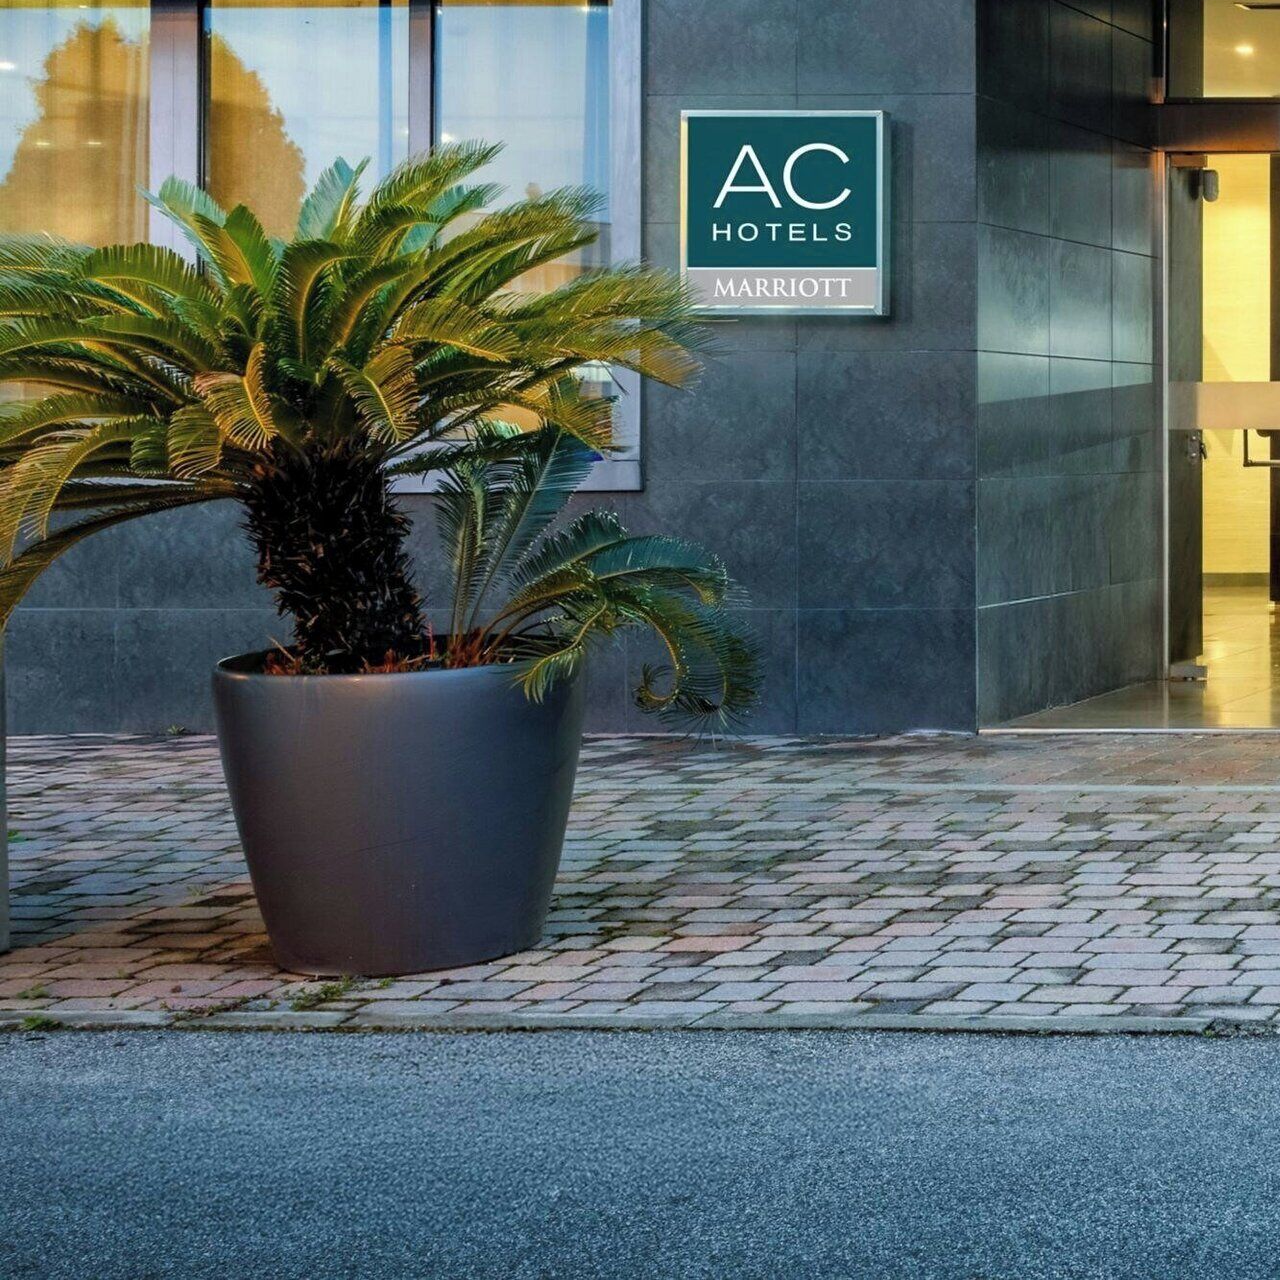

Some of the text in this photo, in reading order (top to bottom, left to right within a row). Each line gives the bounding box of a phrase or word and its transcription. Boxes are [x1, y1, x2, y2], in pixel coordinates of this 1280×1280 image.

[713, 142, 852, 210] AC
[712, 222, 853, 242] HOTELS
[713, 277, 852, 298] MARRIOTT
